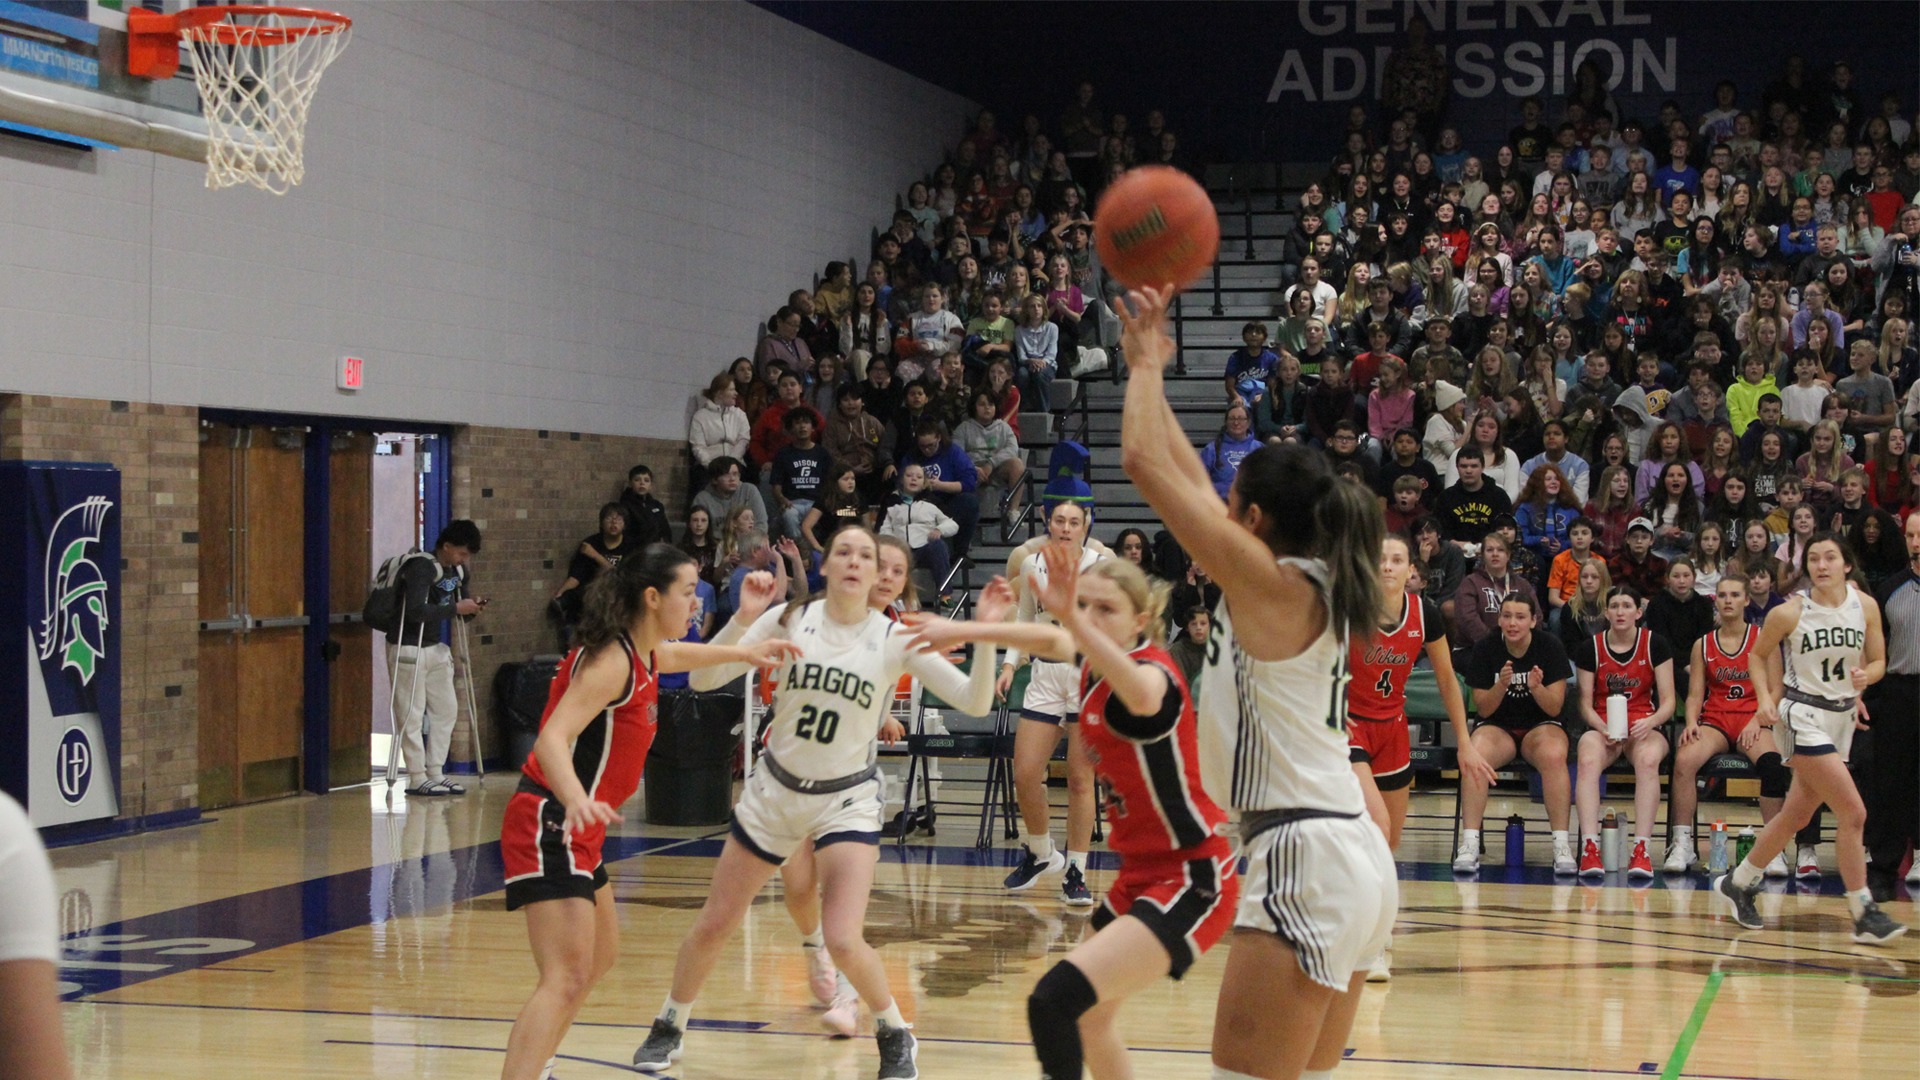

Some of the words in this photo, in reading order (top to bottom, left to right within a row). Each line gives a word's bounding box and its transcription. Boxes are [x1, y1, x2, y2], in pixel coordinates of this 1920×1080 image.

[1267, 37, 1678, 103] ADSSION
[793, 459, 818, 468] BISON
[1364, 644, 1409, 666] Vikes
[1800, 626, 1864, 655] ARGOS
[1375, 668, 1393, 698] 4
[1821, 657, 1846, 683] 14
[785, 663, 875, 710] ARGOS
[795, 704, 840, 745] 20
[925, 738, 955, 748] ARGOS
